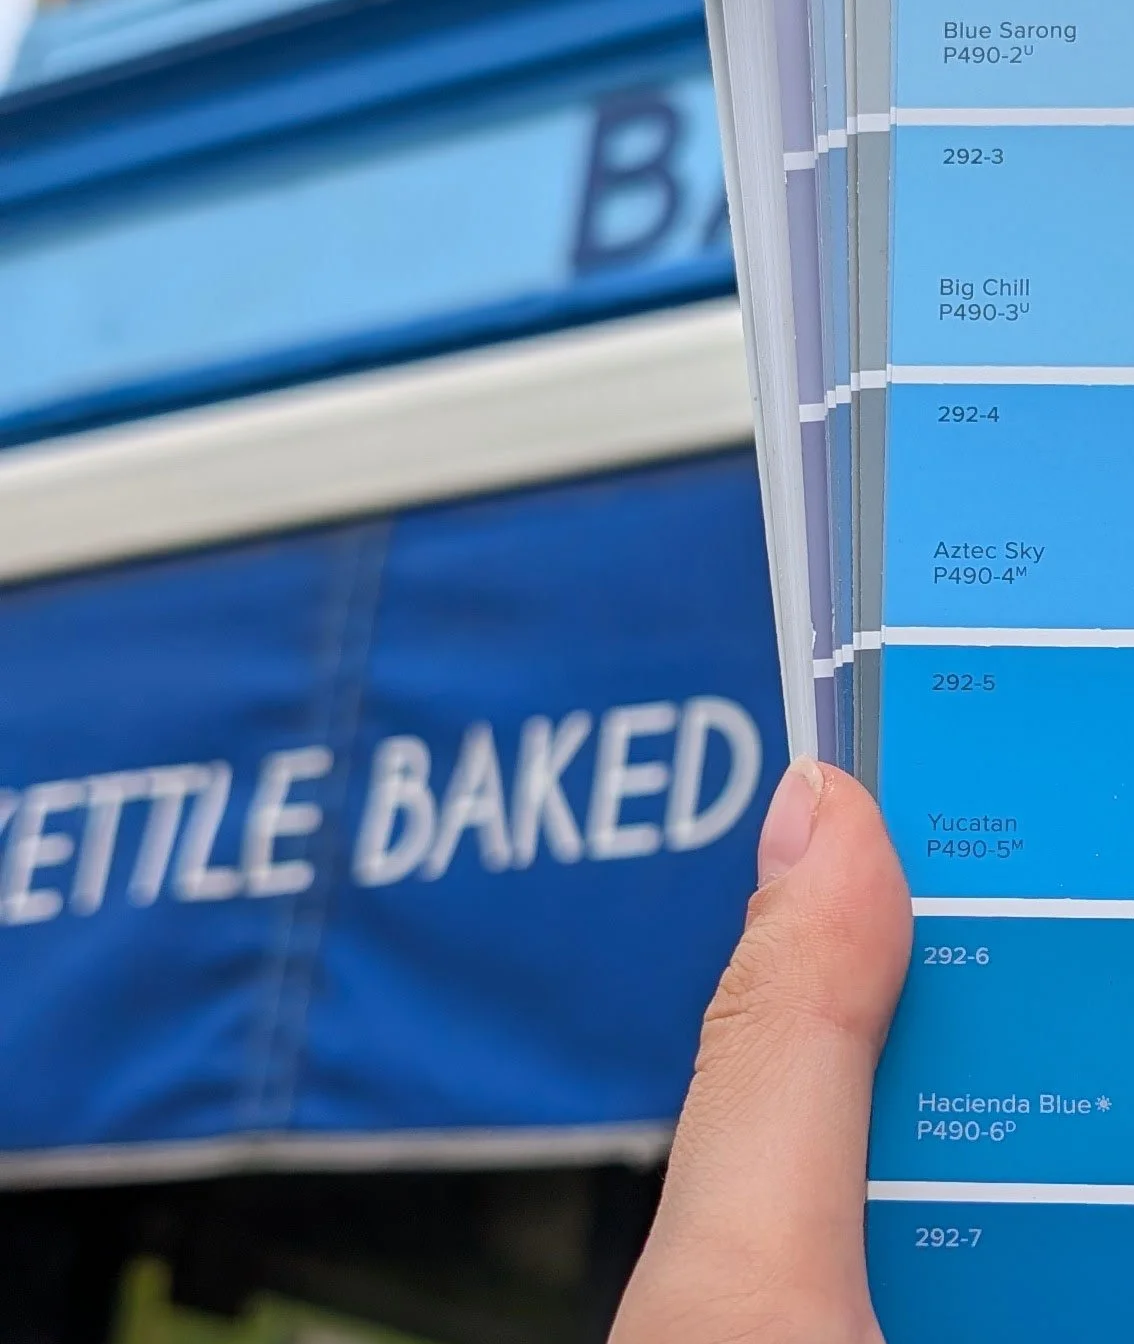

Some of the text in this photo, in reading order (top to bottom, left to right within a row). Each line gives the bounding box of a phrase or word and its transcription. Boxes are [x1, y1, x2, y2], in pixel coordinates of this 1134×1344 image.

[944, 20, 1078, 44] Blue Sarong
[942, 148, 1004, 166] 292-3
[939, 278, 1030, 301] Big Chill
[938, 405, 1000, 424] 292-4
[933, 540, 1046, 564] Aztec Sky
[931, 672, 996, 693] 292-5
[0, 694, 763, 926] ETTLE BAKED
[927, 813, 1019, 833] Yucatan
[924, 946, 990, 965] 292-6
[918, 1092, 1092, 1114] Hacienda Blue
[915, 1227, 982, 1248] 292-7
